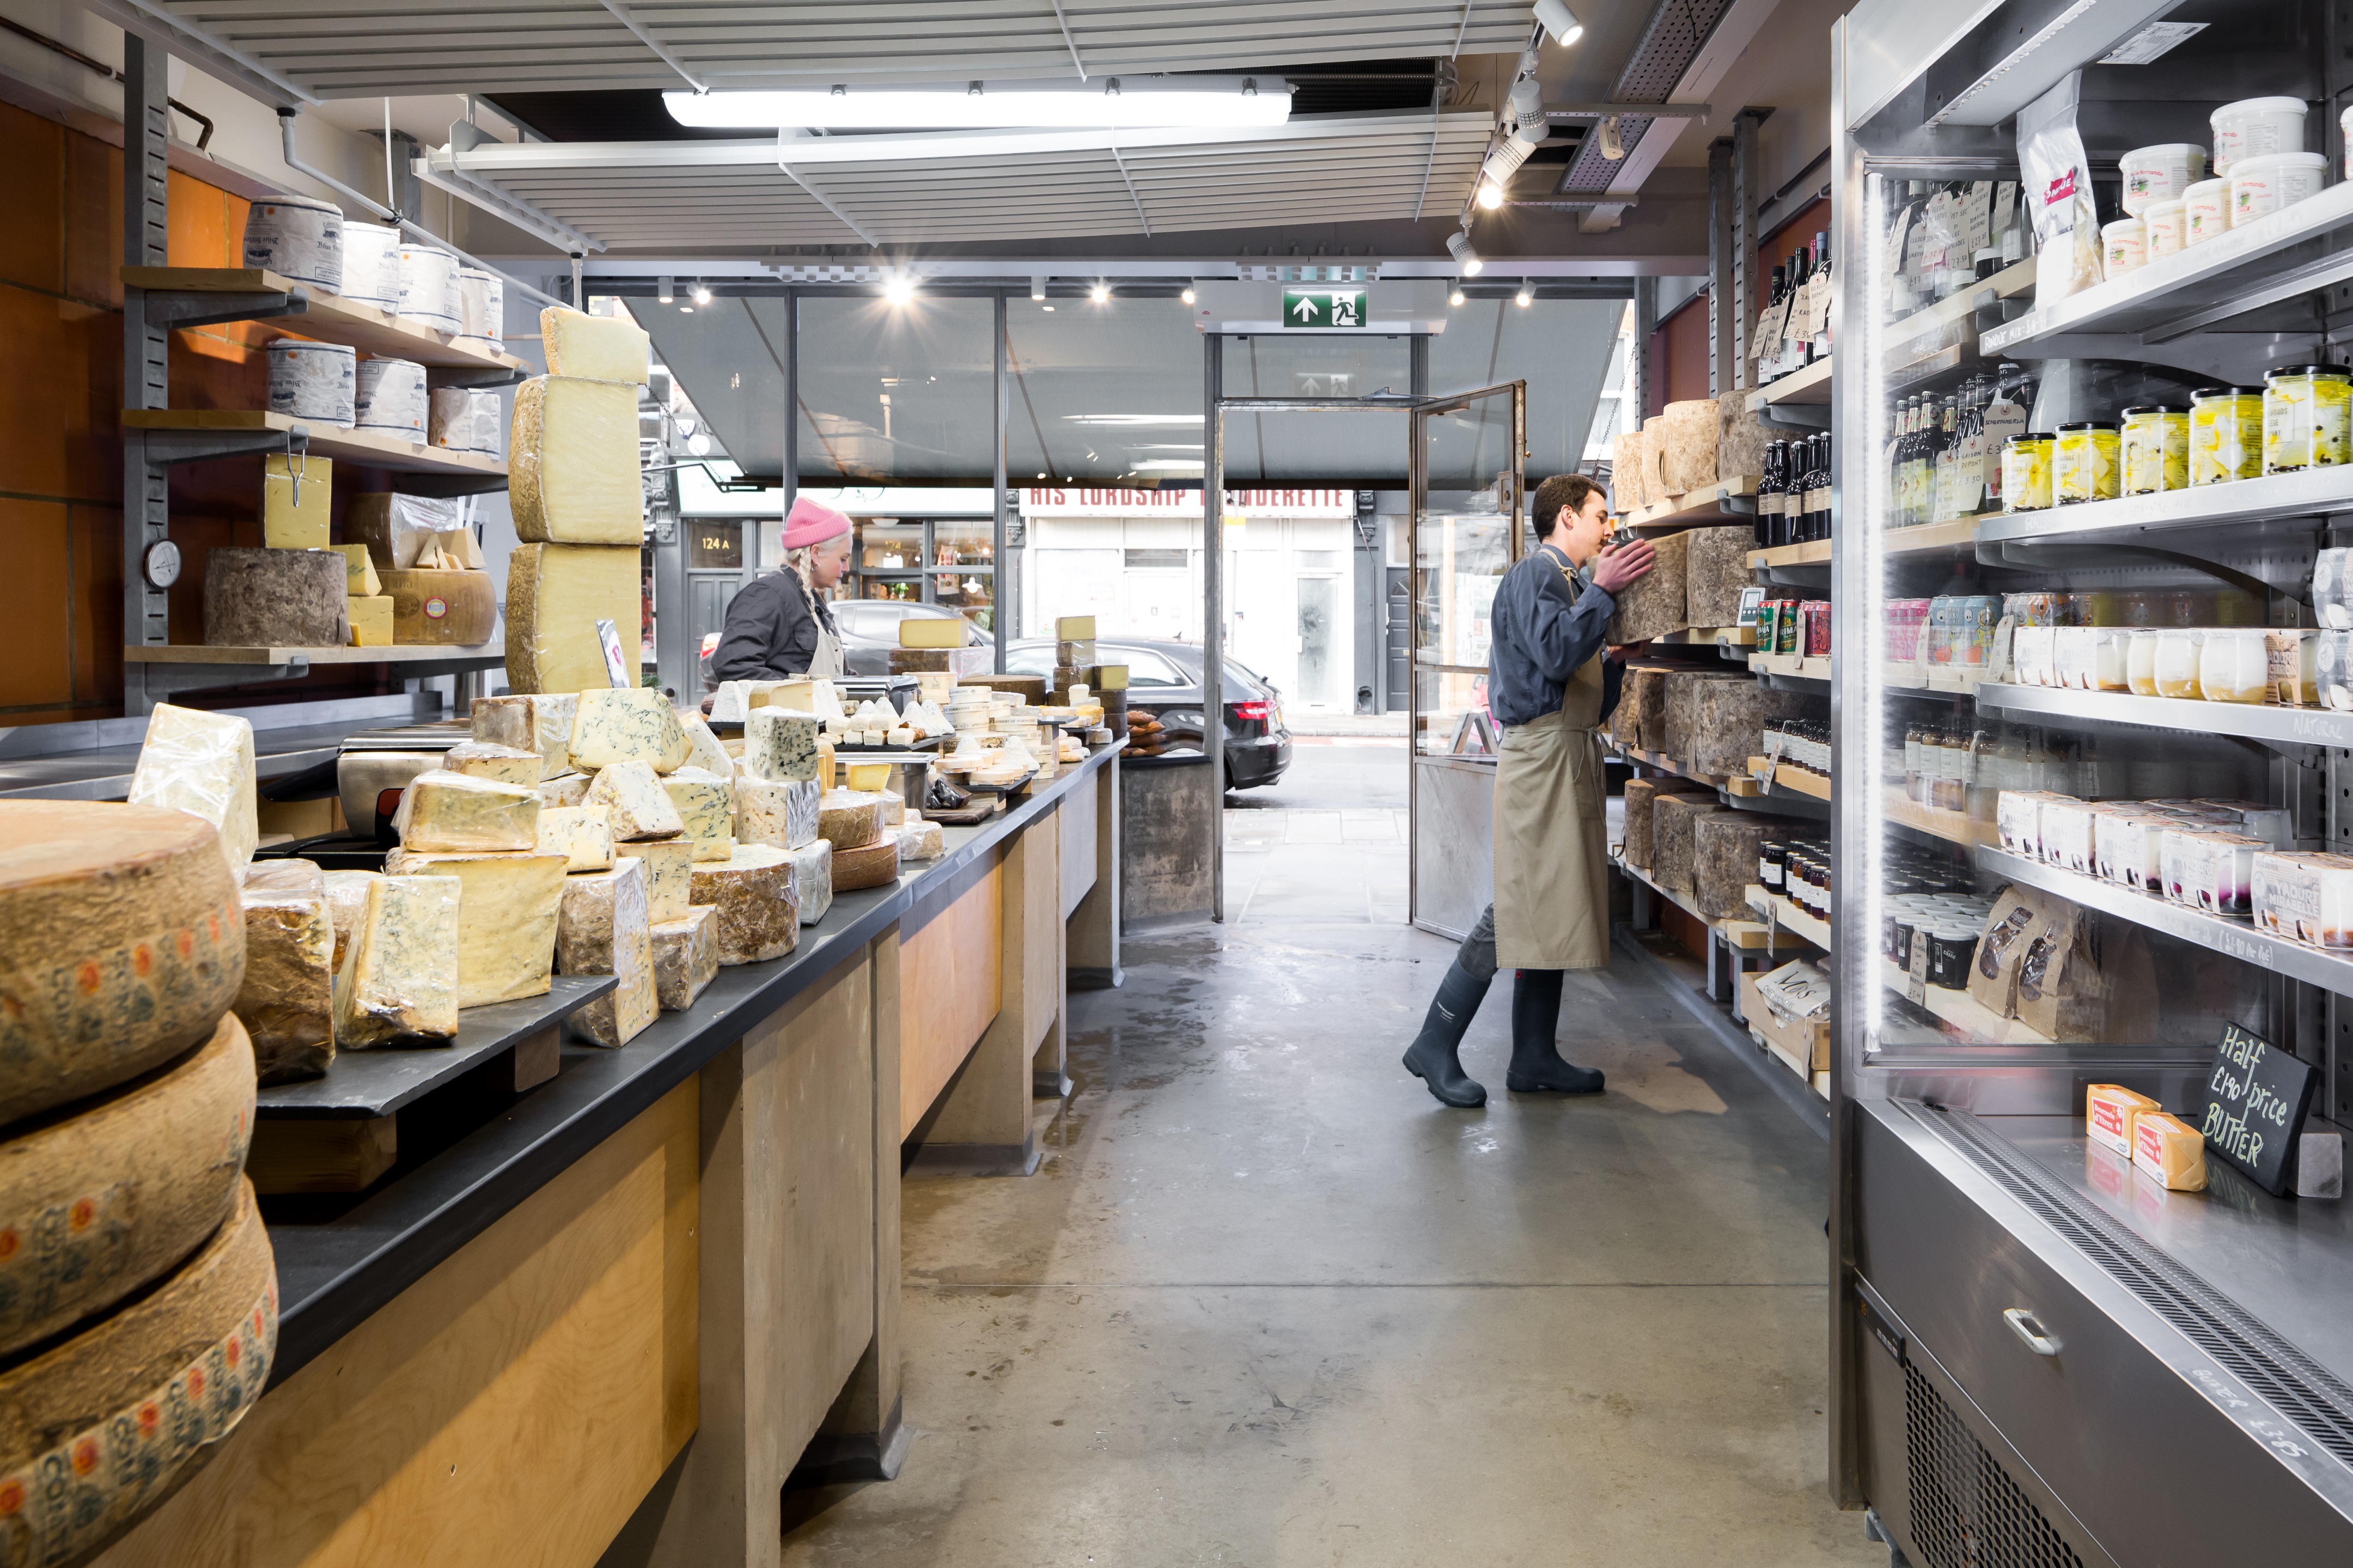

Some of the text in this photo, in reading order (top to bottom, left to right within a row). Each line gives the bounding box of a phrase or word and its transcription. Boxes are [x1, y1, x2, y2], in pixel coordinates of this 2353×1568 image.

[1985, 331, 2007, 351] FONDUE
[1961, 450, 1982, 460] SAISON
[1988, 444, 2001, 455] £3
[1961, 459, 1982, 469] DUPONT
[1030, 488, 1065, 505] HIS
[1080, 488, 1186, 506] LORDSHIP
[702, 538, 729, 550] 124 A
[885, 540, 901, 551] 124
[2267, 651, 2297, 664] AOURT
[2270, 663, 2297, 675] CITRON
[2294, 713, 2344, 740] NATURAL
[2256, 859, 2279, 872] TERROIR
[2276, 880, 2320, 901] YAOURT
[2269, 893, 2319, 915] MIRABELLE
[2220, 1026, 2266, 1096] Half
[2211, 1066, 2241, 1101] £1.90
[2094, 1103, 2115, 1120] Beurrerie
[2241, 1082, 2287, 1129] price
[2139, 1130, 2156, 1148] Beurrerie
[2202, 1102, 2264, 1168] BUTTER
